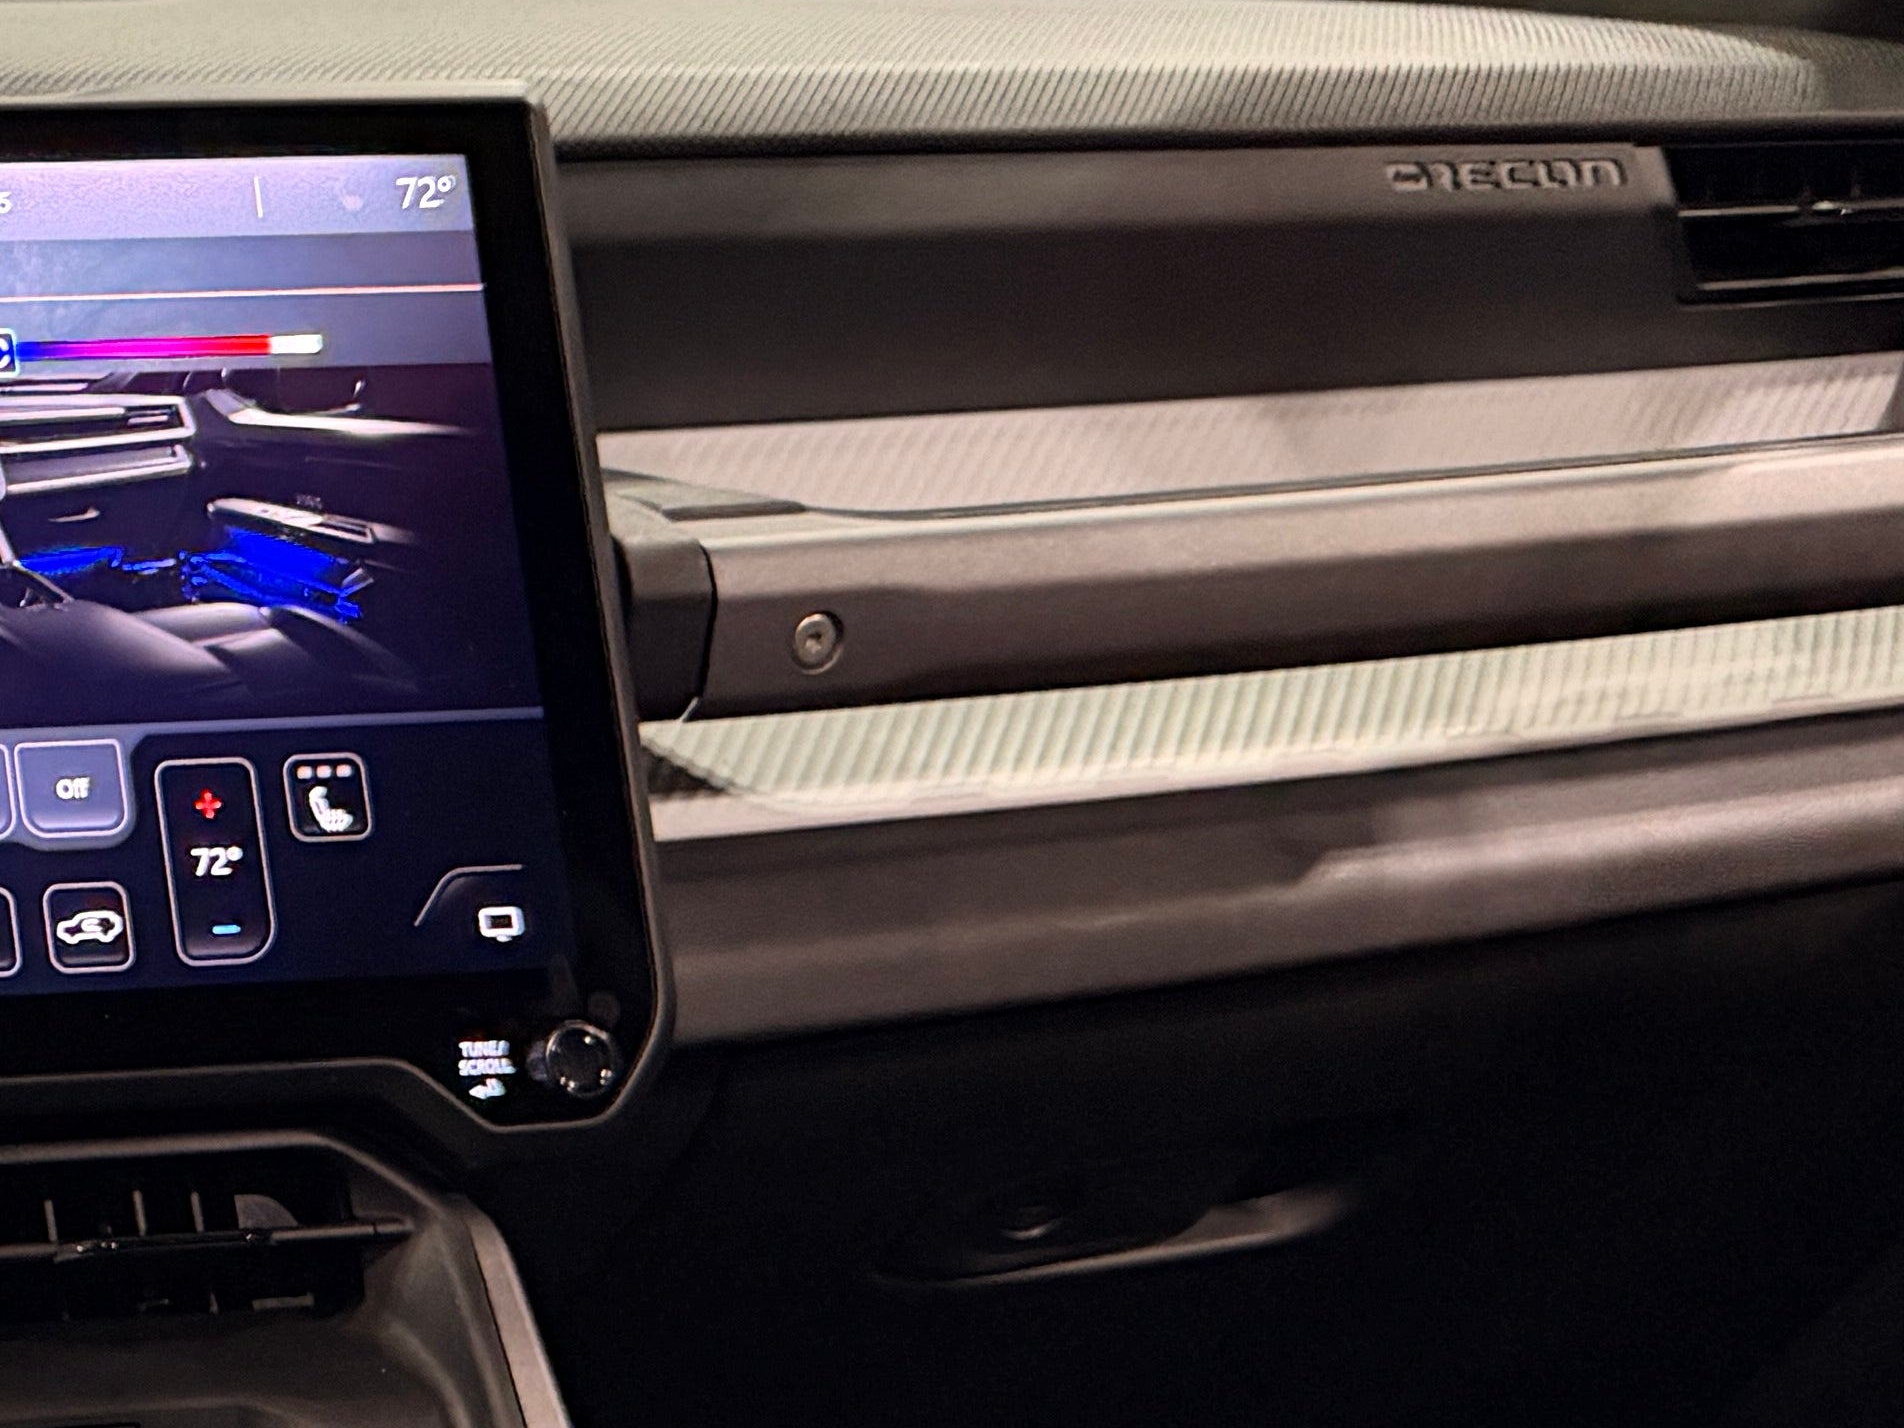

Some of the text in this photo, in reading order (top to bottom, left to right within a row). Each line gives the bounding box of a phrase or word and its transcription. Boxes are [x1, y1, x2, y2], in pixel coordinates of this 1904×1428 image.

[396, 175, 456, 209] 72°
[55, 777, 91, 800] Off
[190, 845, 244, 878] 72°
